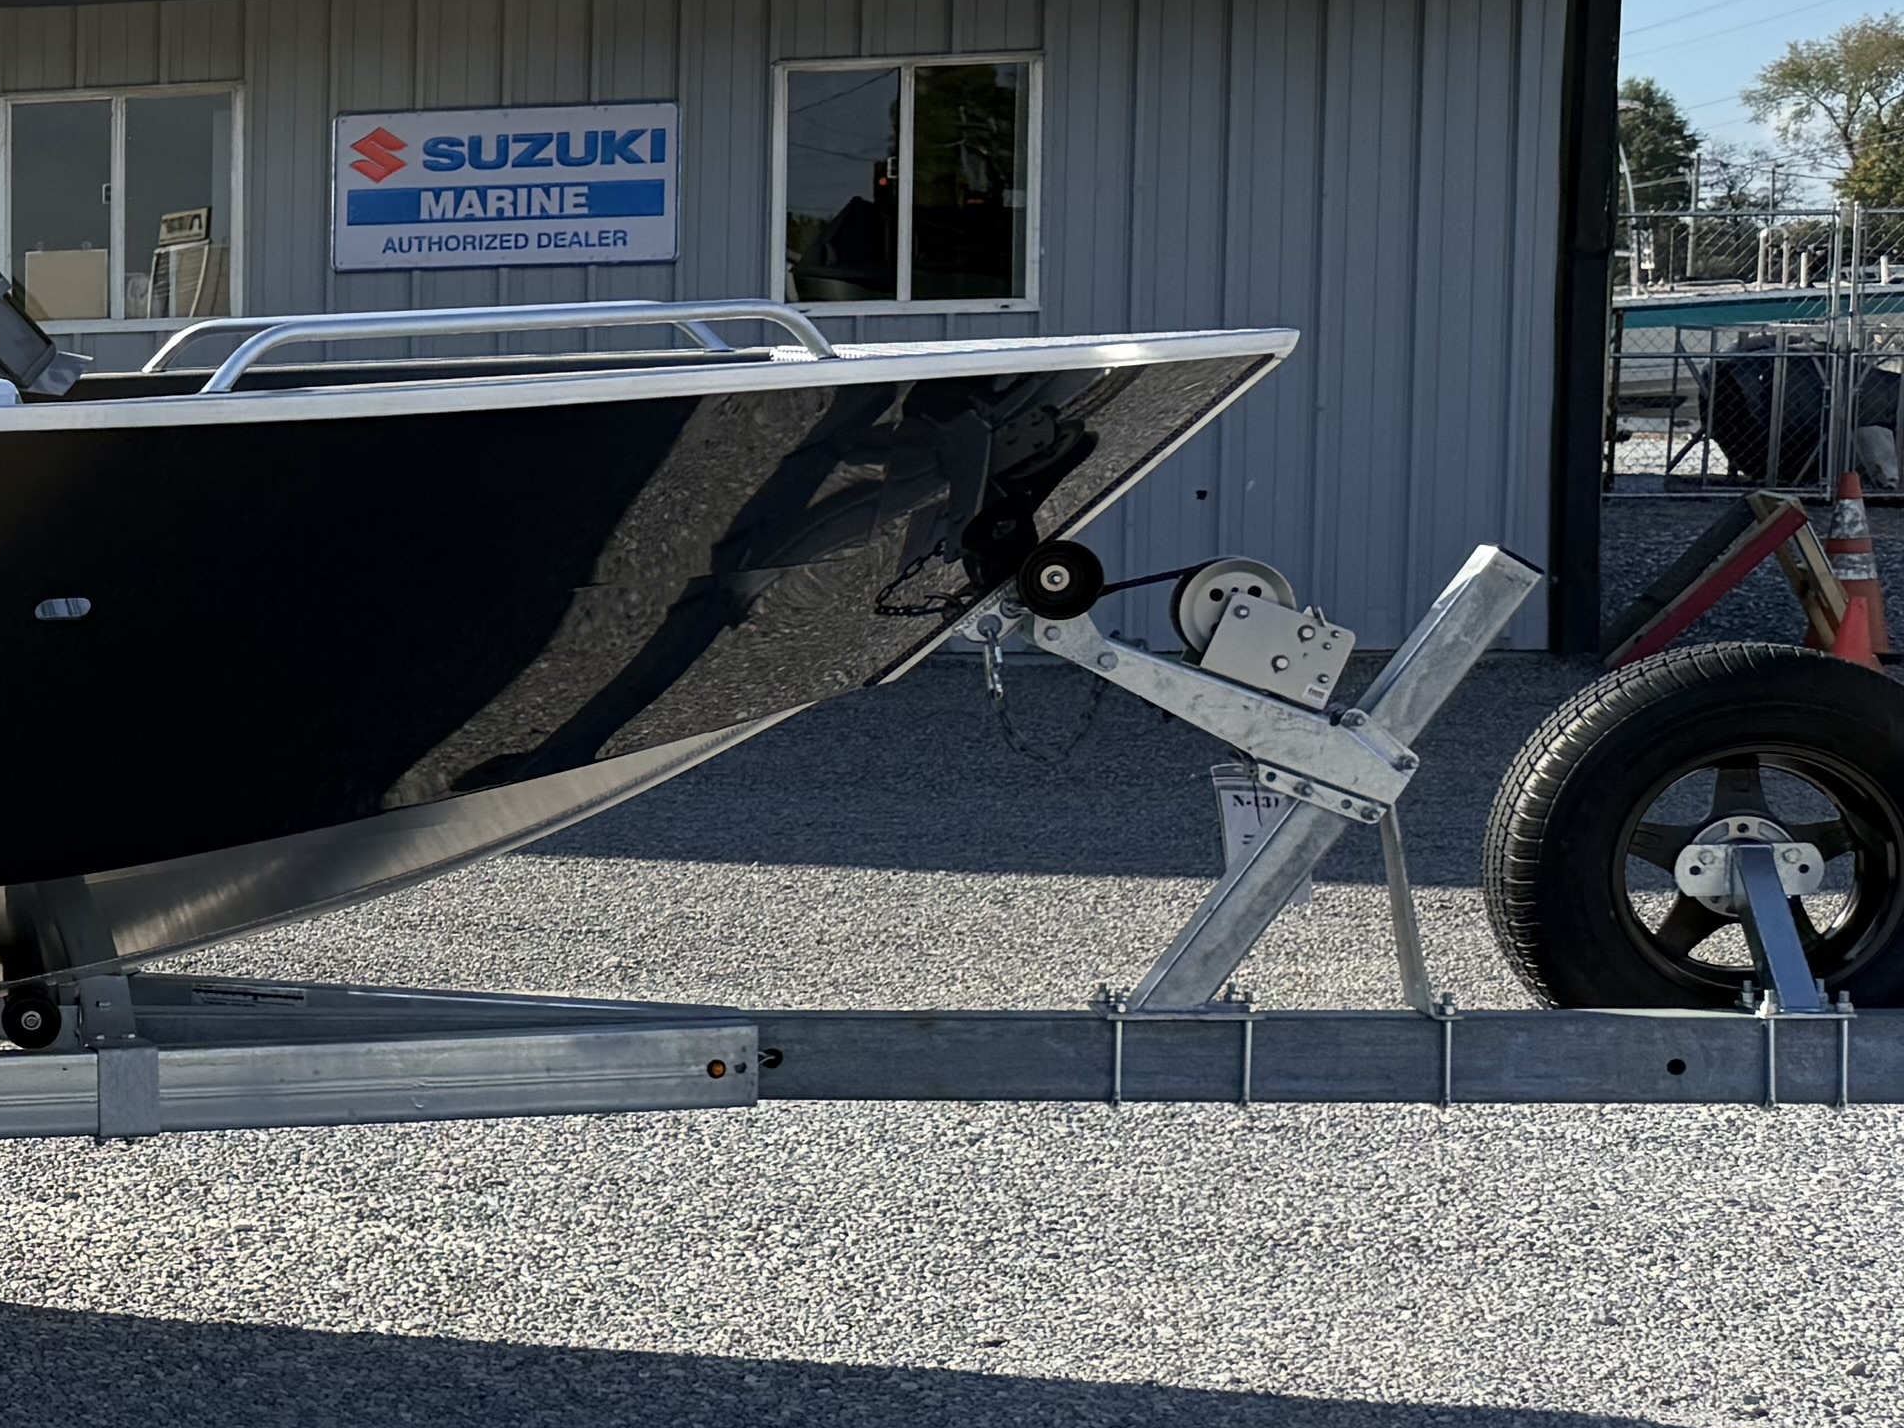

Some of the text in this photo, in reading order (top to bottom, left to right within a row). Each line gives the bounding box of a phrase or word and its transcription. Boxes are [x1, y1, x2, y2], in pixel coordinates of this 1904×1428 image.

[422, 128, 666, 172] SUZUKI
[419, 185, 589, 220] MARINE
[382, 229, 628, 254] AUTHORIZED DEALER
